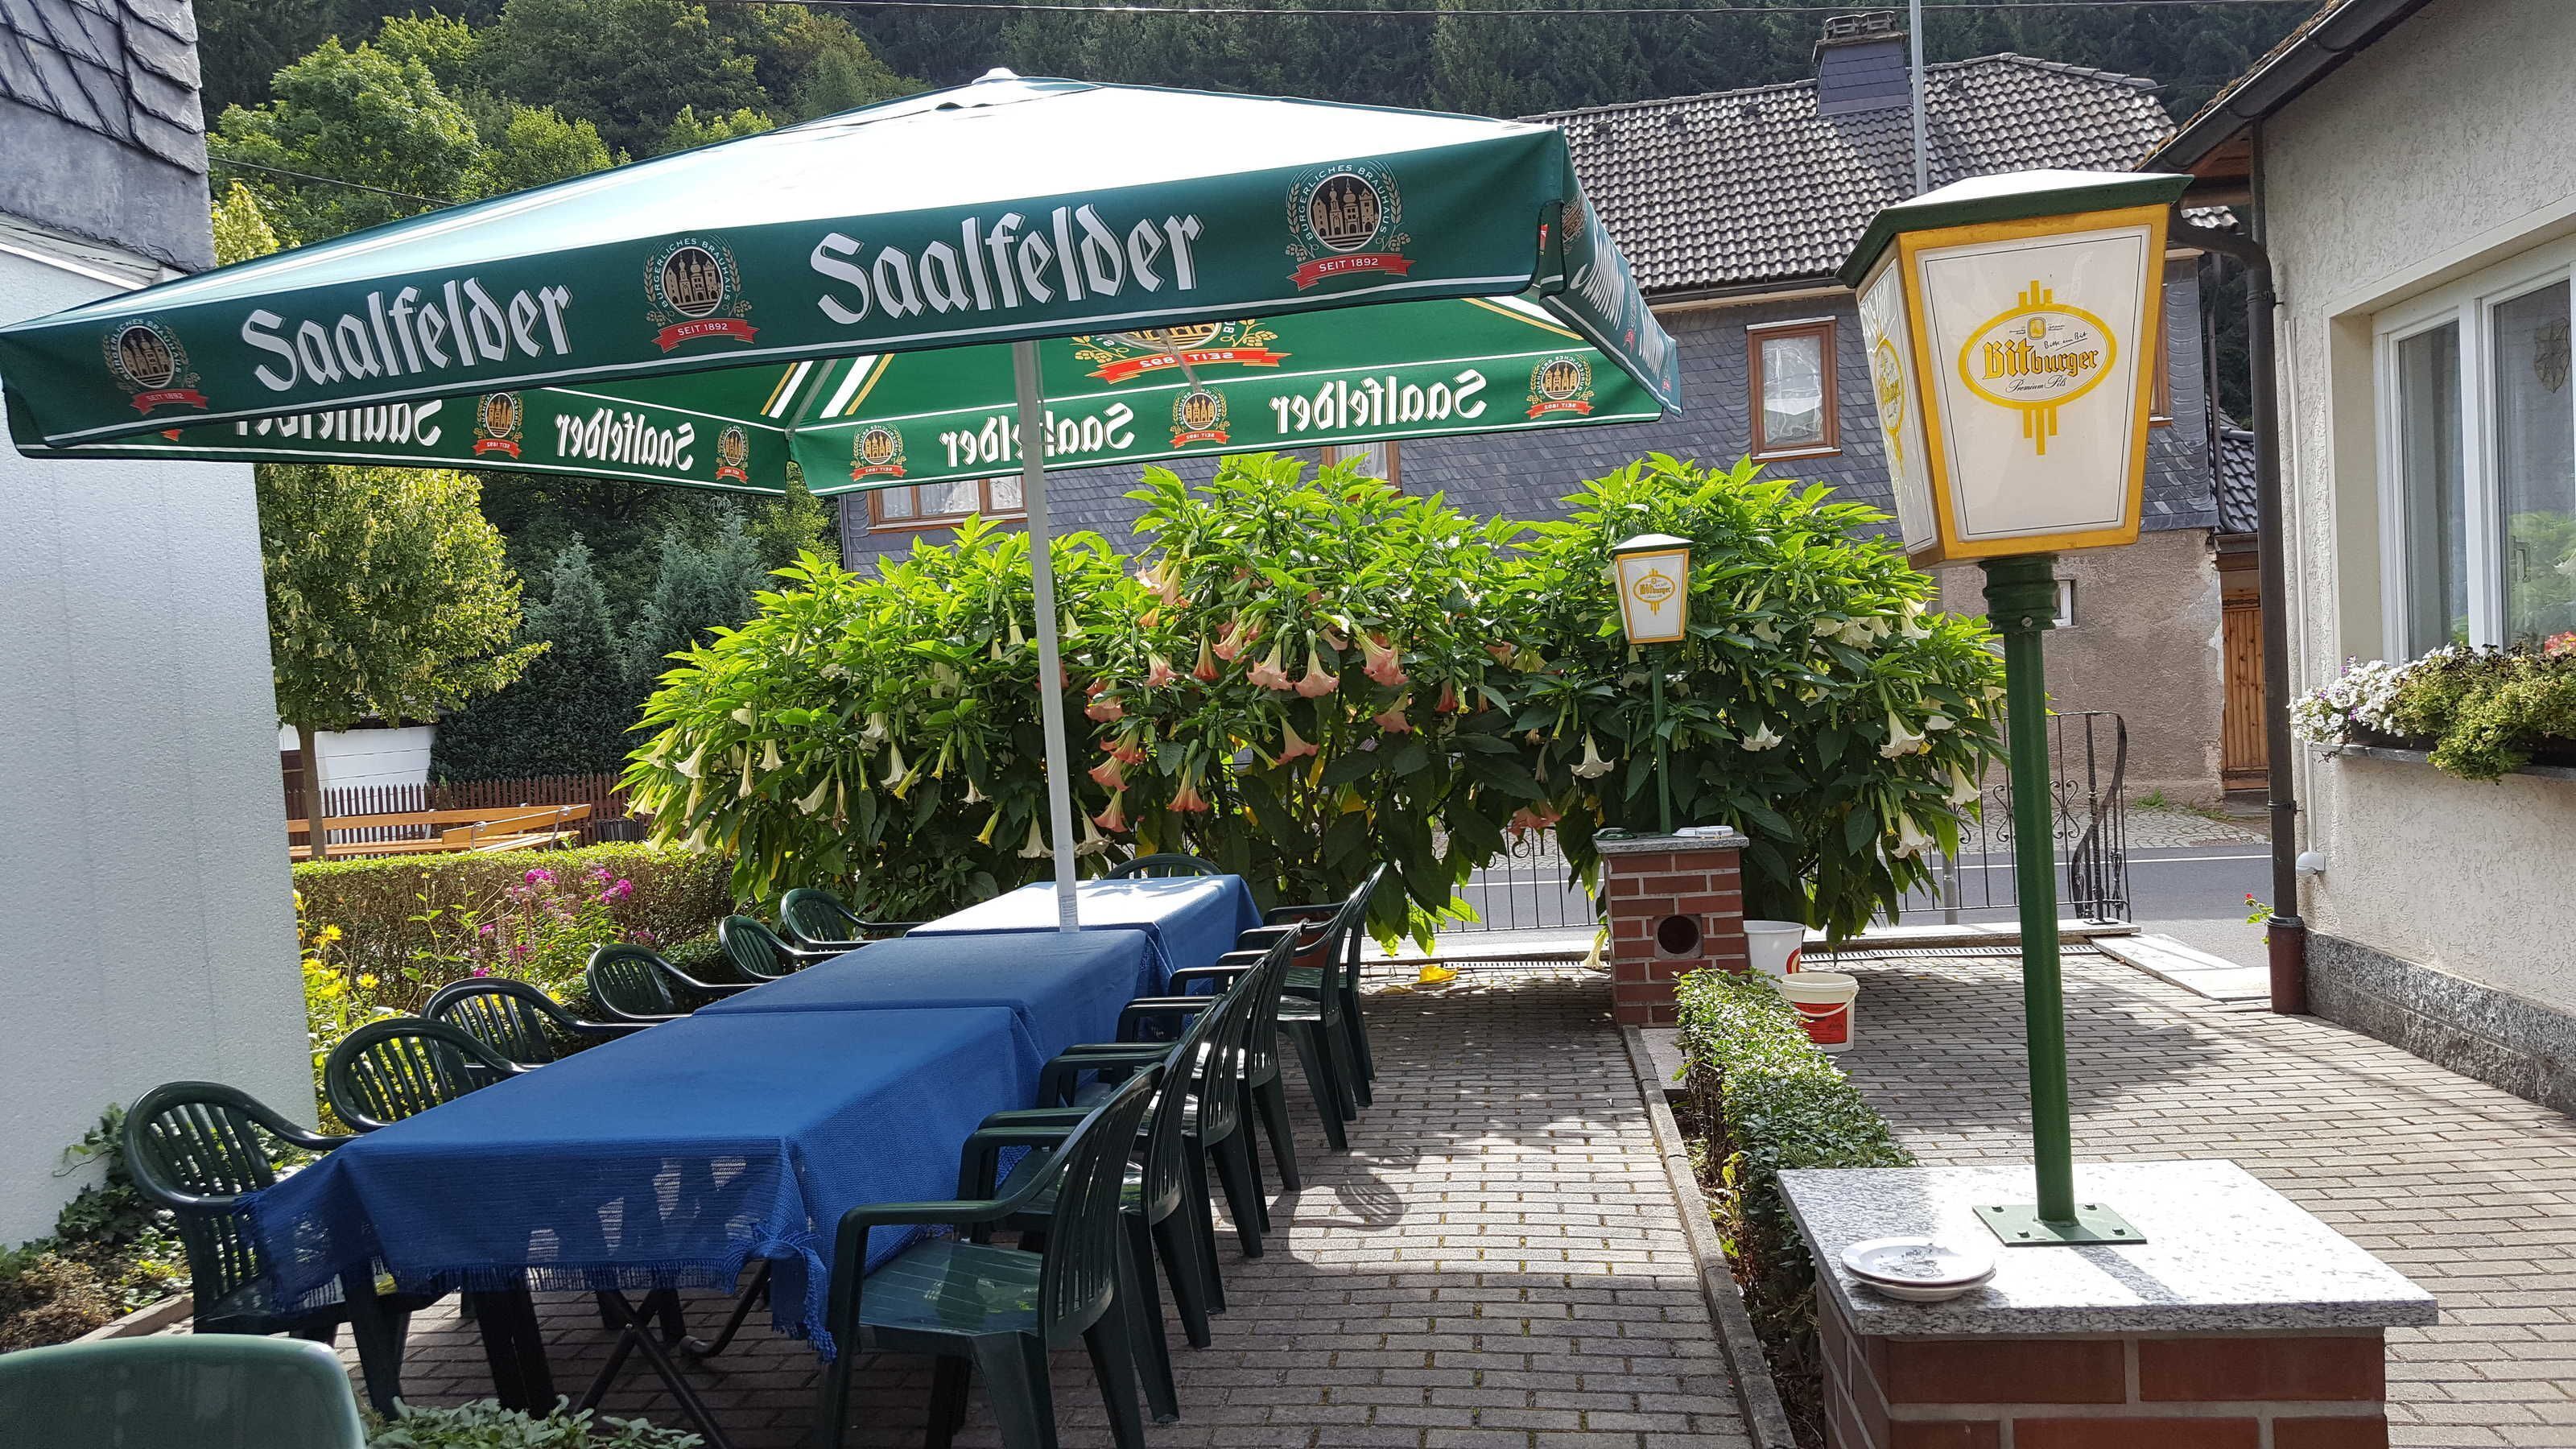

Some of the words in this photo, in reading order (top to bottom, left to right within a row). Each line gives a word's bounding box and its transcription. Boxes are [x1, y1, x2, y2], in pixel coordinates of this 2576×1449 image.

[1357, 167, 1392, 233] BRAUHAUS
[701, 241, 732, 301] BRAUHAUS
[810, 203, 1204, 324] Saalfelder
[1319, 260, 1347, 272] SEIT
[1351, 258, 1379, 267] 1892
[242, 277, 572, 391] Saalfelder
[677, 324, 700, 336] SEIT
[704, 323, 729, 331] 1892
[2074, 331, 2087, 340] Bit
[1983, 337, 2099, 380] Bitburger
[165, 392, 185, 400] 1892
[2005, 379, 2044, 393] Premium
[2044, 374, 2067, 389] Pils
